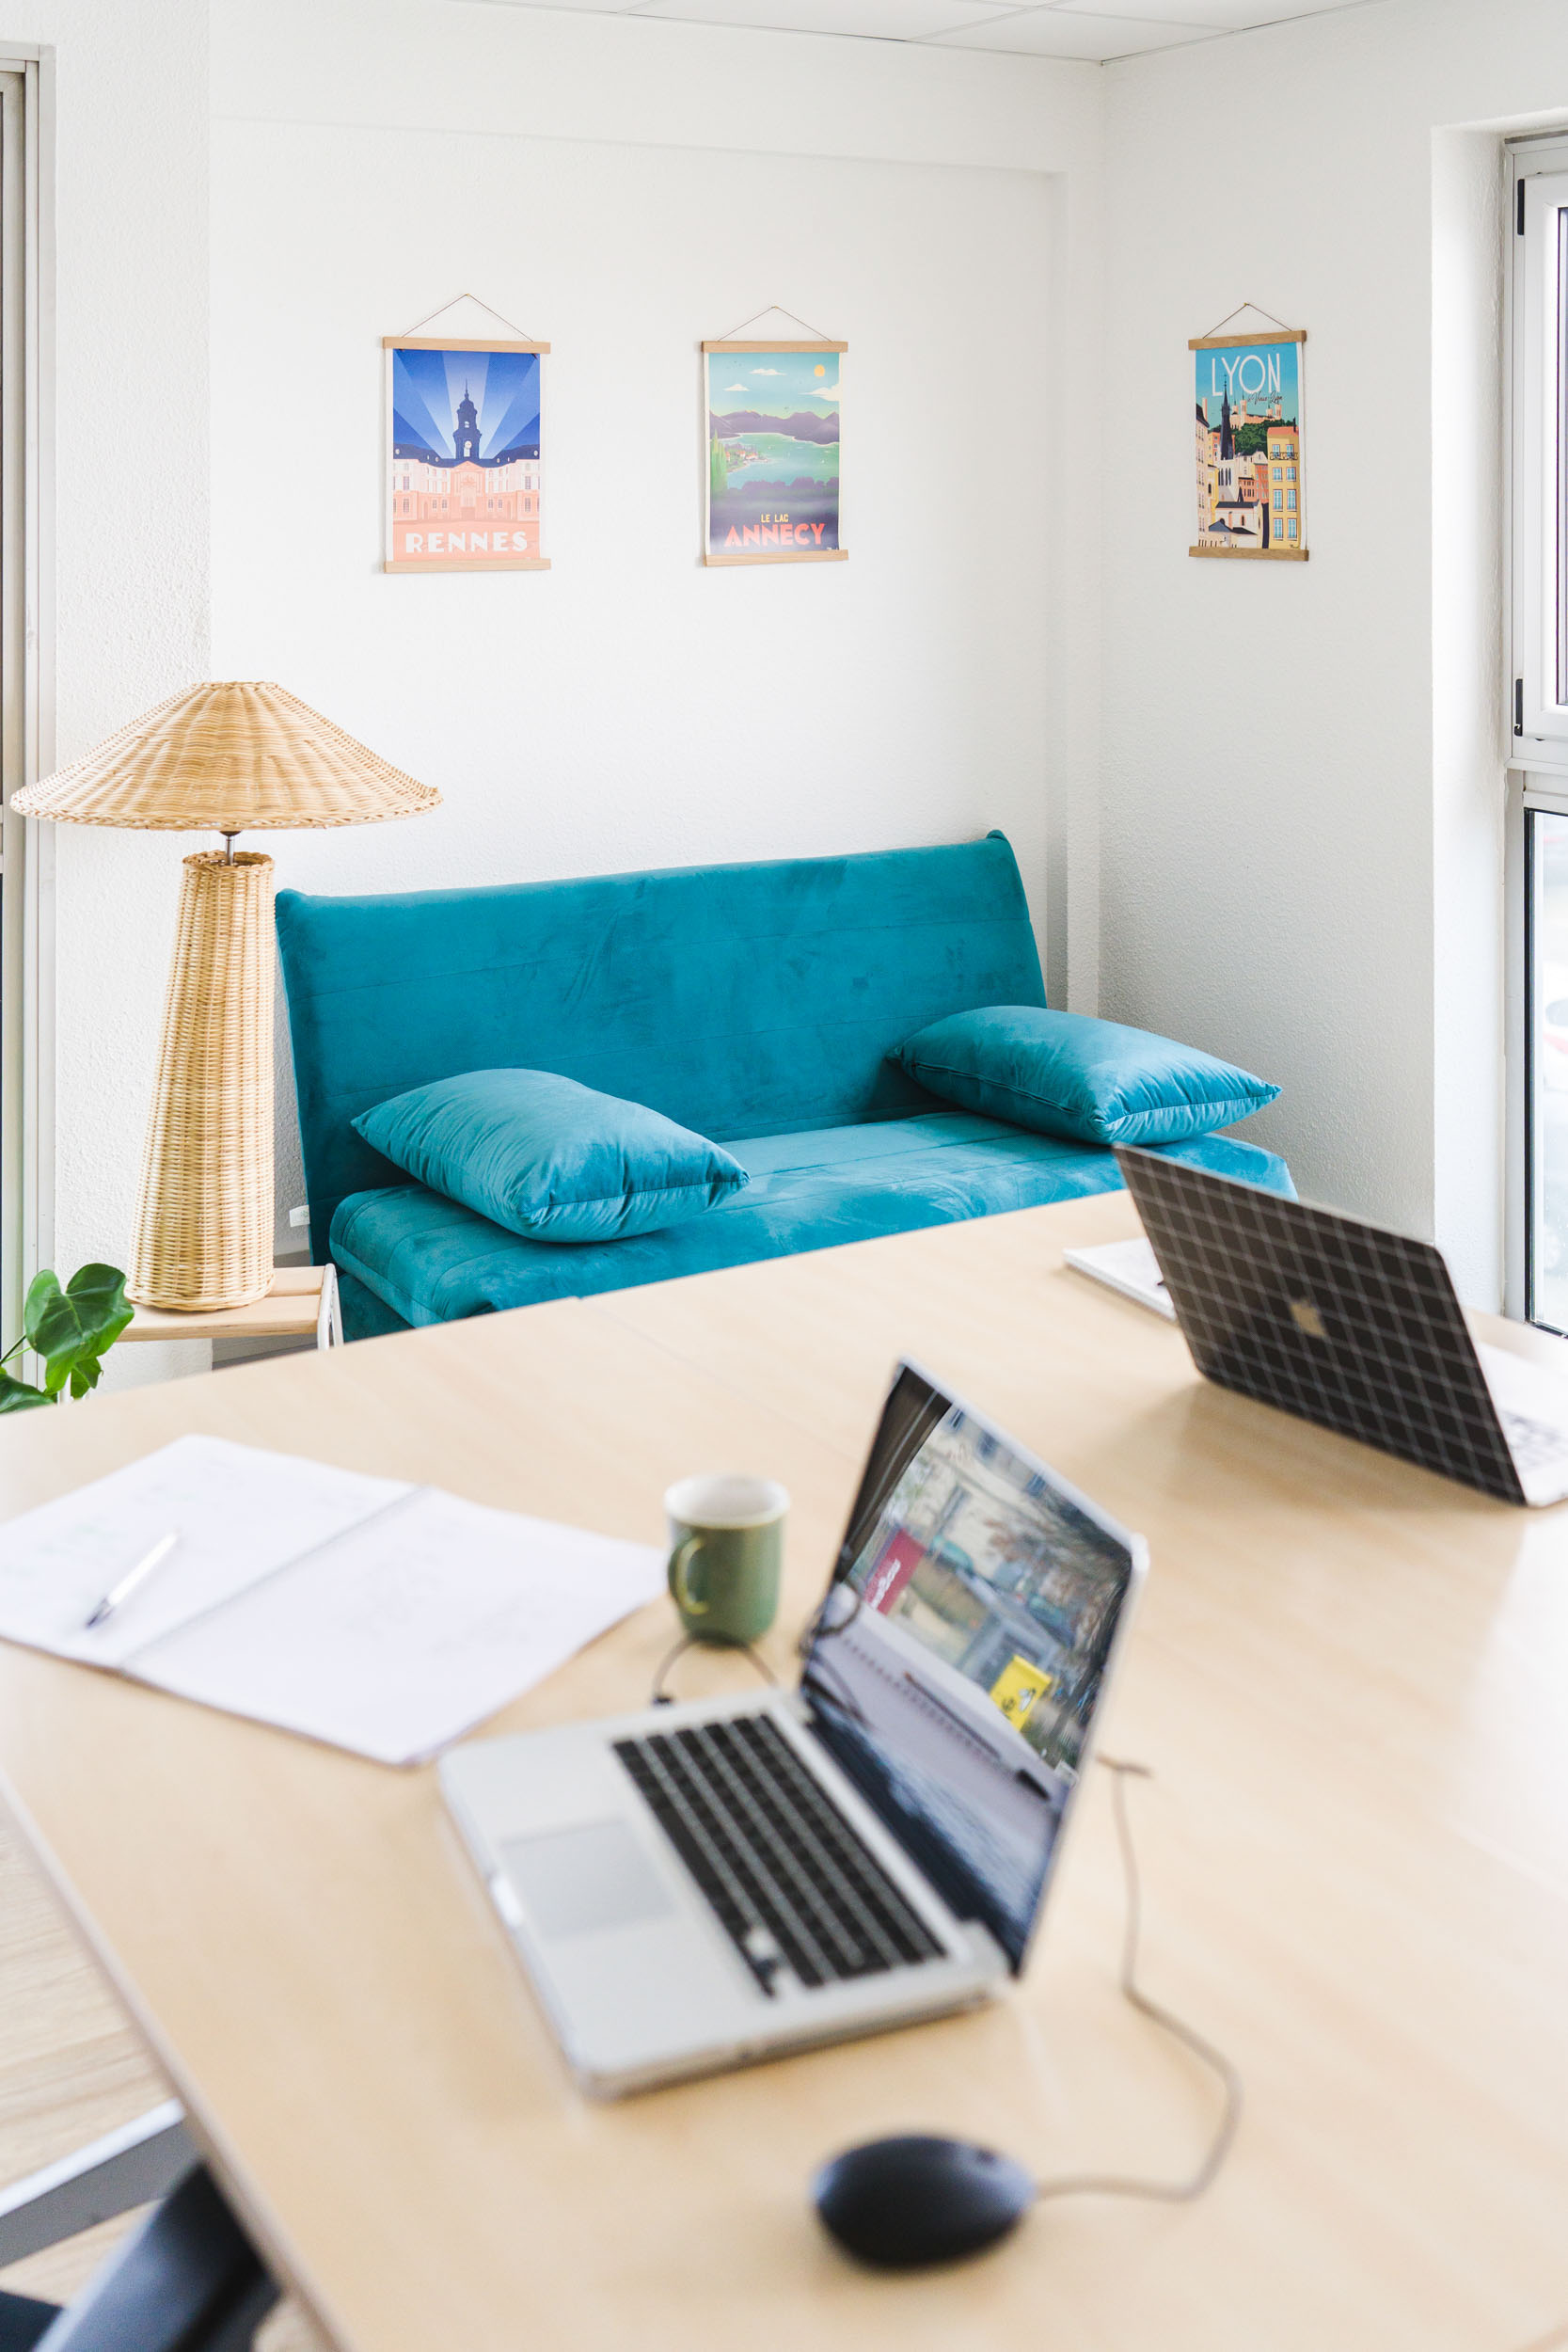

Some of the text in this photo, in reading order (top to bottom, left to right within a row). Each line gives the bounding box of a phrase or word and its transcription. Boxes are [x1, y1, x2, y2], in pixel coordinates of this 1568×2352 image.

[1211, 353, 1281, 397] LYON
[760, 513, 790, 523] LE LAC
[404, 531, 529, 554] RENNES
[723, 522, 826, 548] ANNECY
